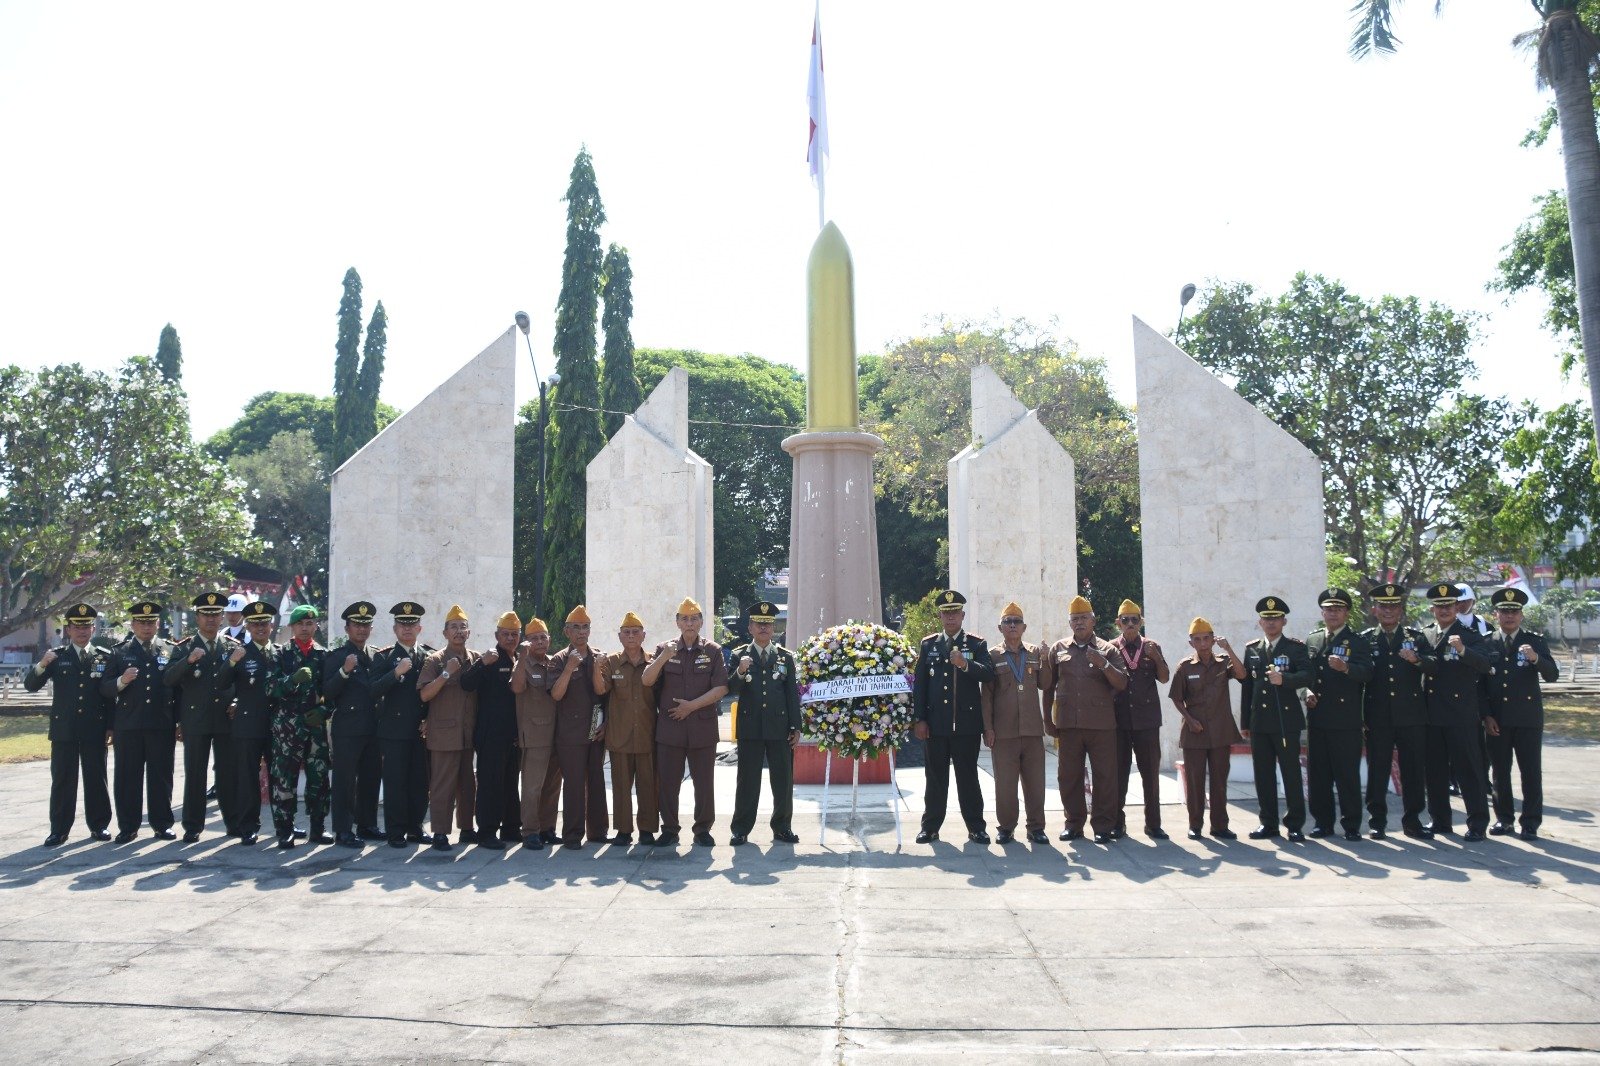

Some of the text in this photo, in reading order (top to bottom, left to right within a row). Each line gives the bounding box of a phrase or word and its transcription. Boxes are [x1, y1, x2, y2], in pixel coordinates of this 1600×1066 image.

[827, 678, 854, 688] ZIARAH
[810, 688, 828, 698] HUT
[830, 687, 839, 696] KE
[842, 685, 853, 693] 78
[854, 684, 866, 692] TNI
[871, 682, 893, 690] TAHUN
